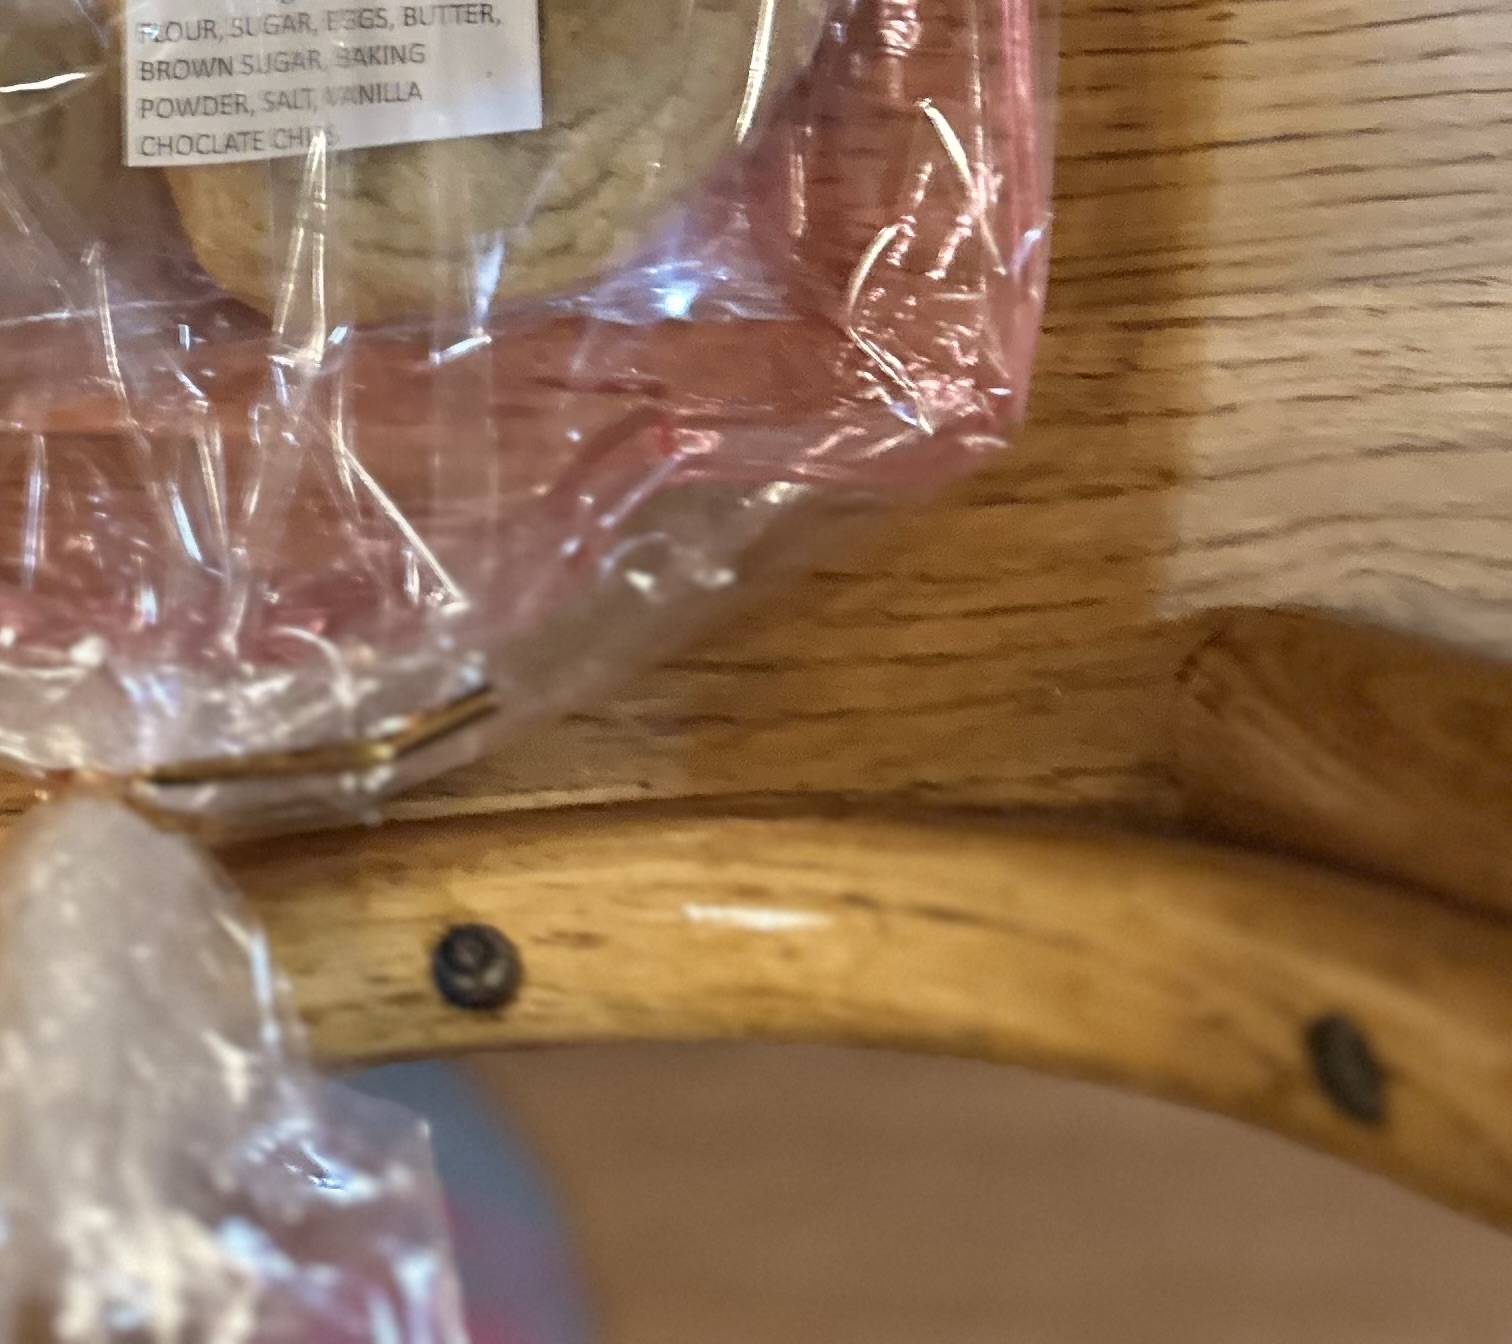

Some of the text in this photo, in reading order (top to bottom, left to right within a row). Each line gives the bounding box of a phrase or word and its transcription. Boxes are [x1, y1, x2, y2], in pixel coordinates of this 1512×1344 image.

[402, 2, 502, 28] BUTTER,
[139, 56, 233, 82] BROWN
[335, 43, 427, 69] BAKING
[140, 81, 423, 120] POWDER, SALT, VANILLA
[138, 130, 264, 157] CHOCLATE
